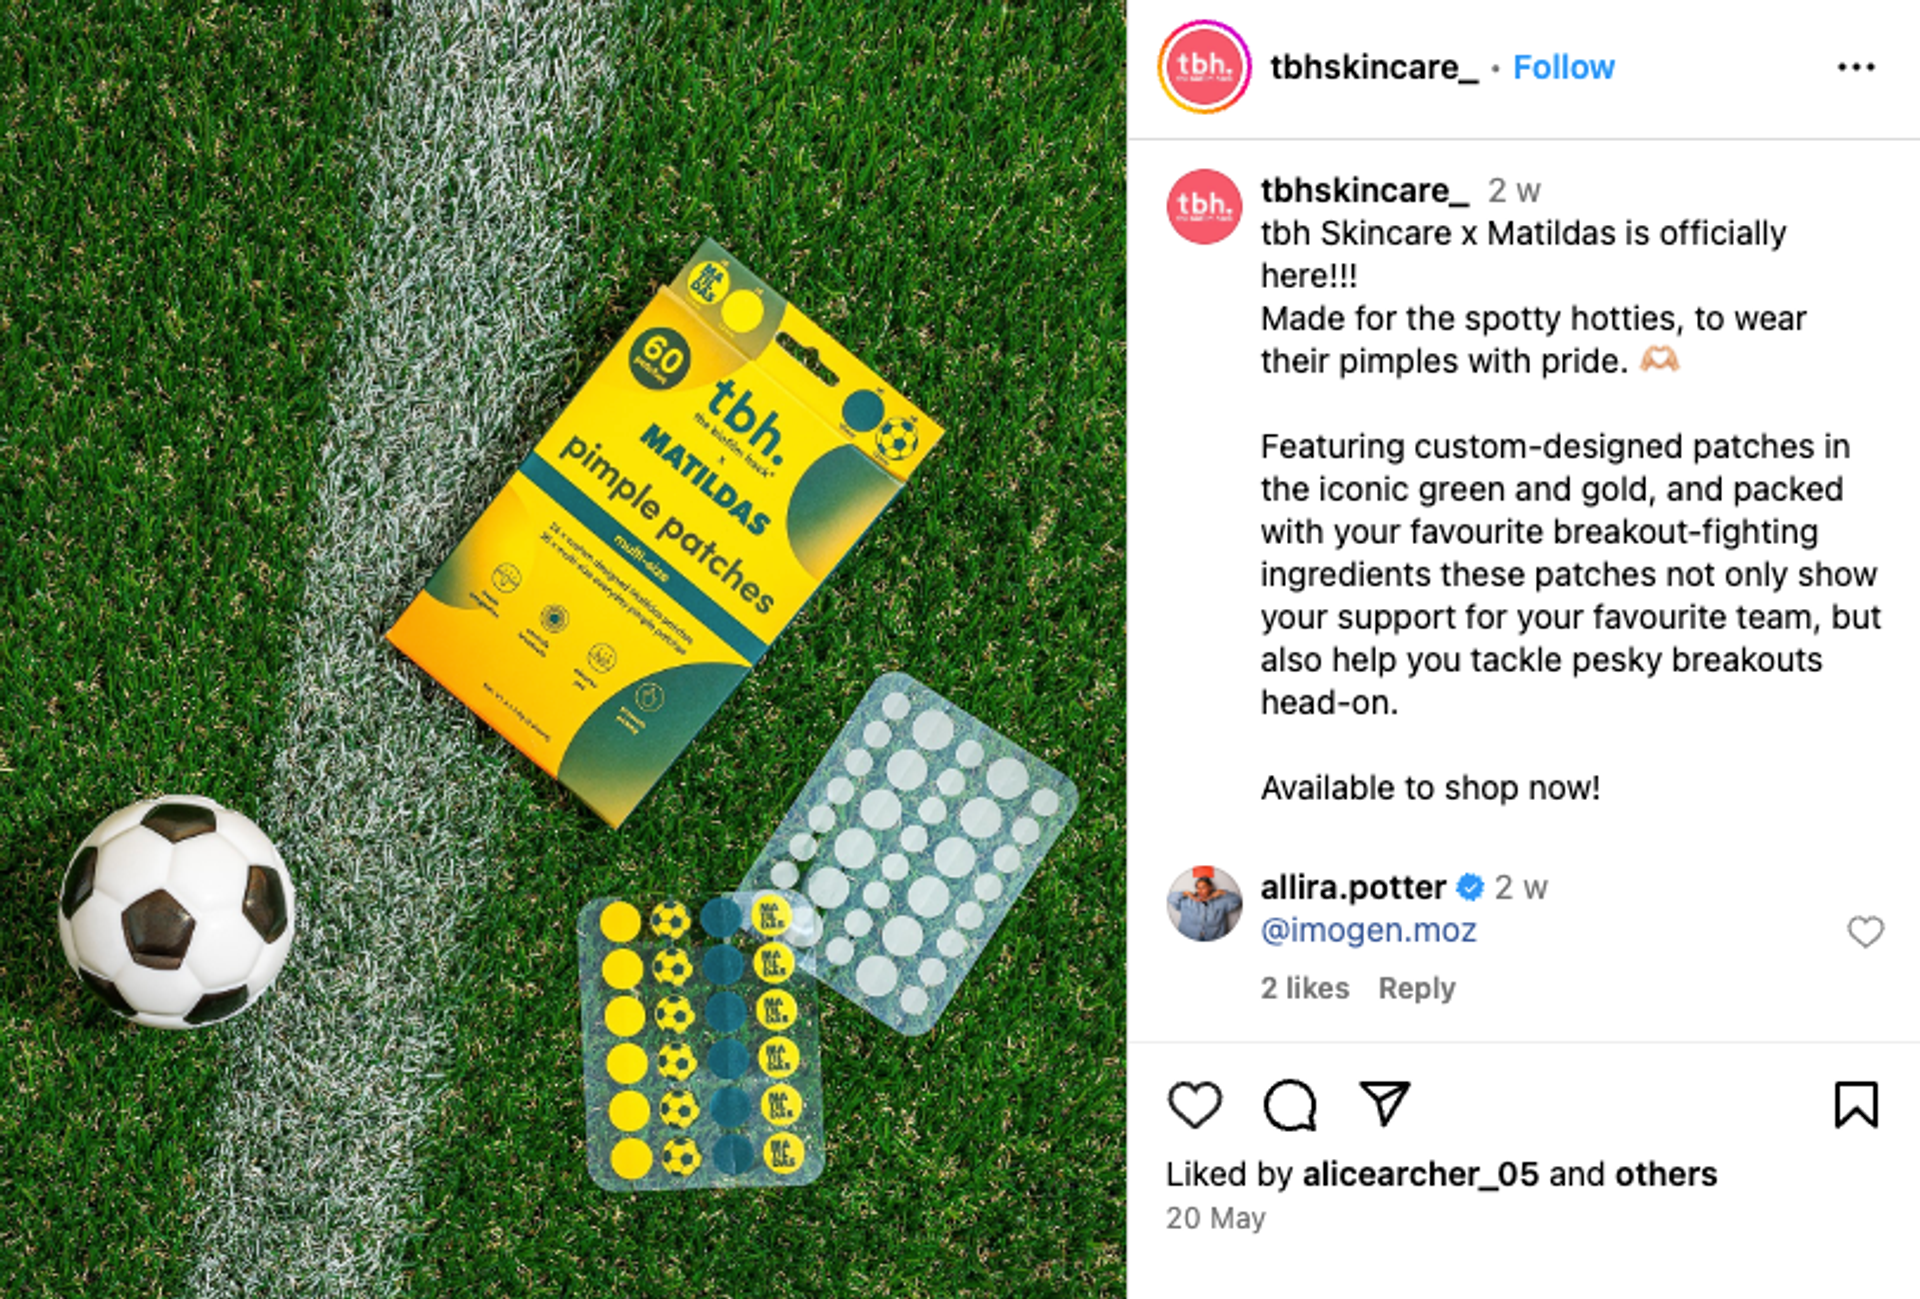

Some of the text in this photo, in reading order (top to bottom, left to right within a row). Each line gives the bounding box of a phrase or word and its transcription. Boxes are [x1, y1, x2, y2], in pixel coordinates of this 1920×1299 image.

[644, 334, 684, 374] 60
[708, 379, 784, 467] tbh.
[639, 423, 772, 536] MATILDAS
[559, 435, 775, 615] pimple patches
[613, 534, 671, 584] multi-size
